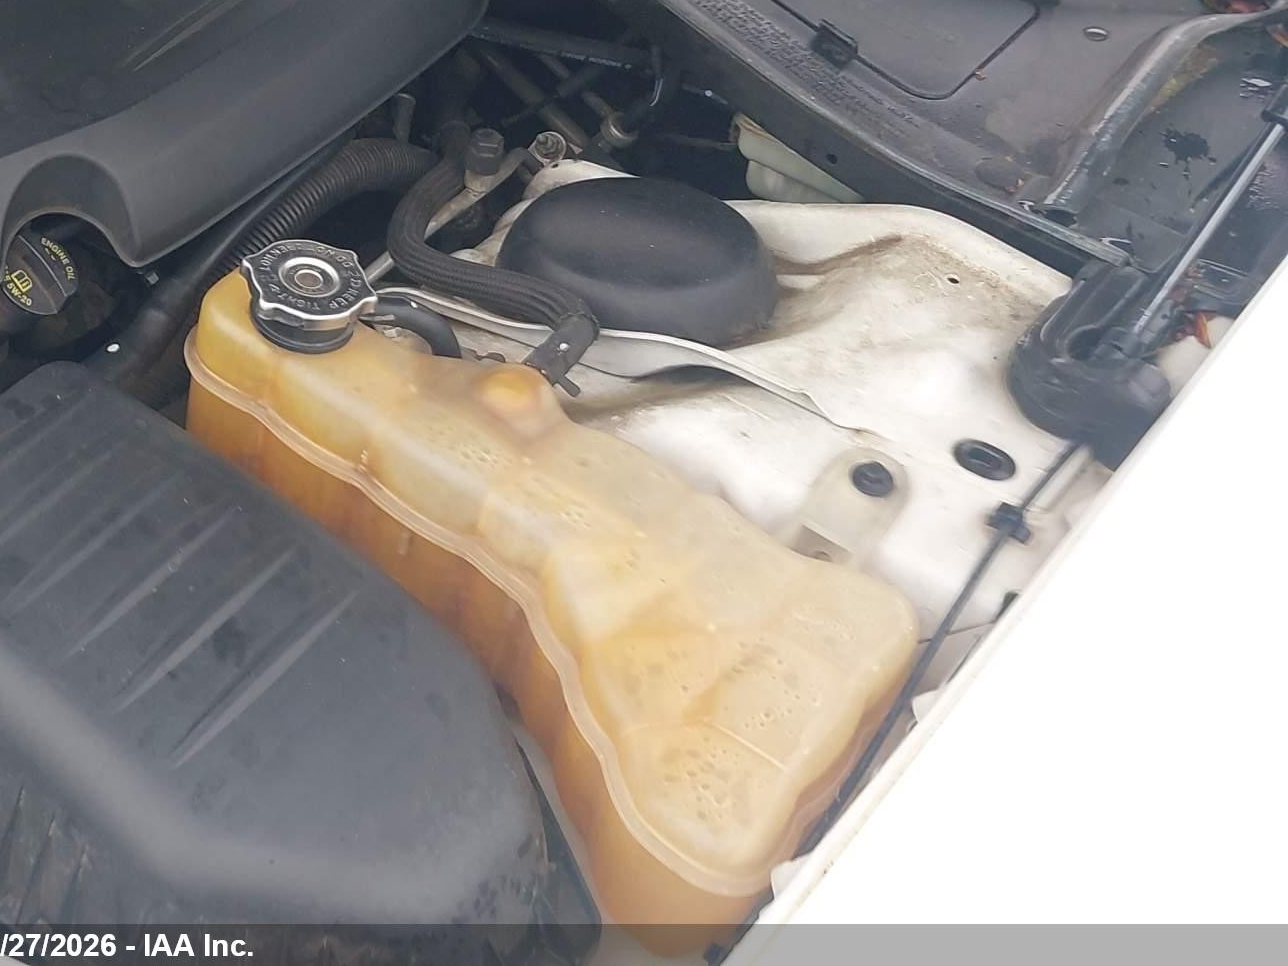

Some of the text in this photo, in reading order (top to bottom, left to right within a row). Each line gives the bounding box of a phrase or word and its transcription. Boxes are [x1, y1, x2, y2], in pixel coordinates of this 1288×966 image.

[40, 237, 71, 265] ENGINE
[65, 266, 76, 281] OIL
[6, 282, 33, 307] 5W-20
